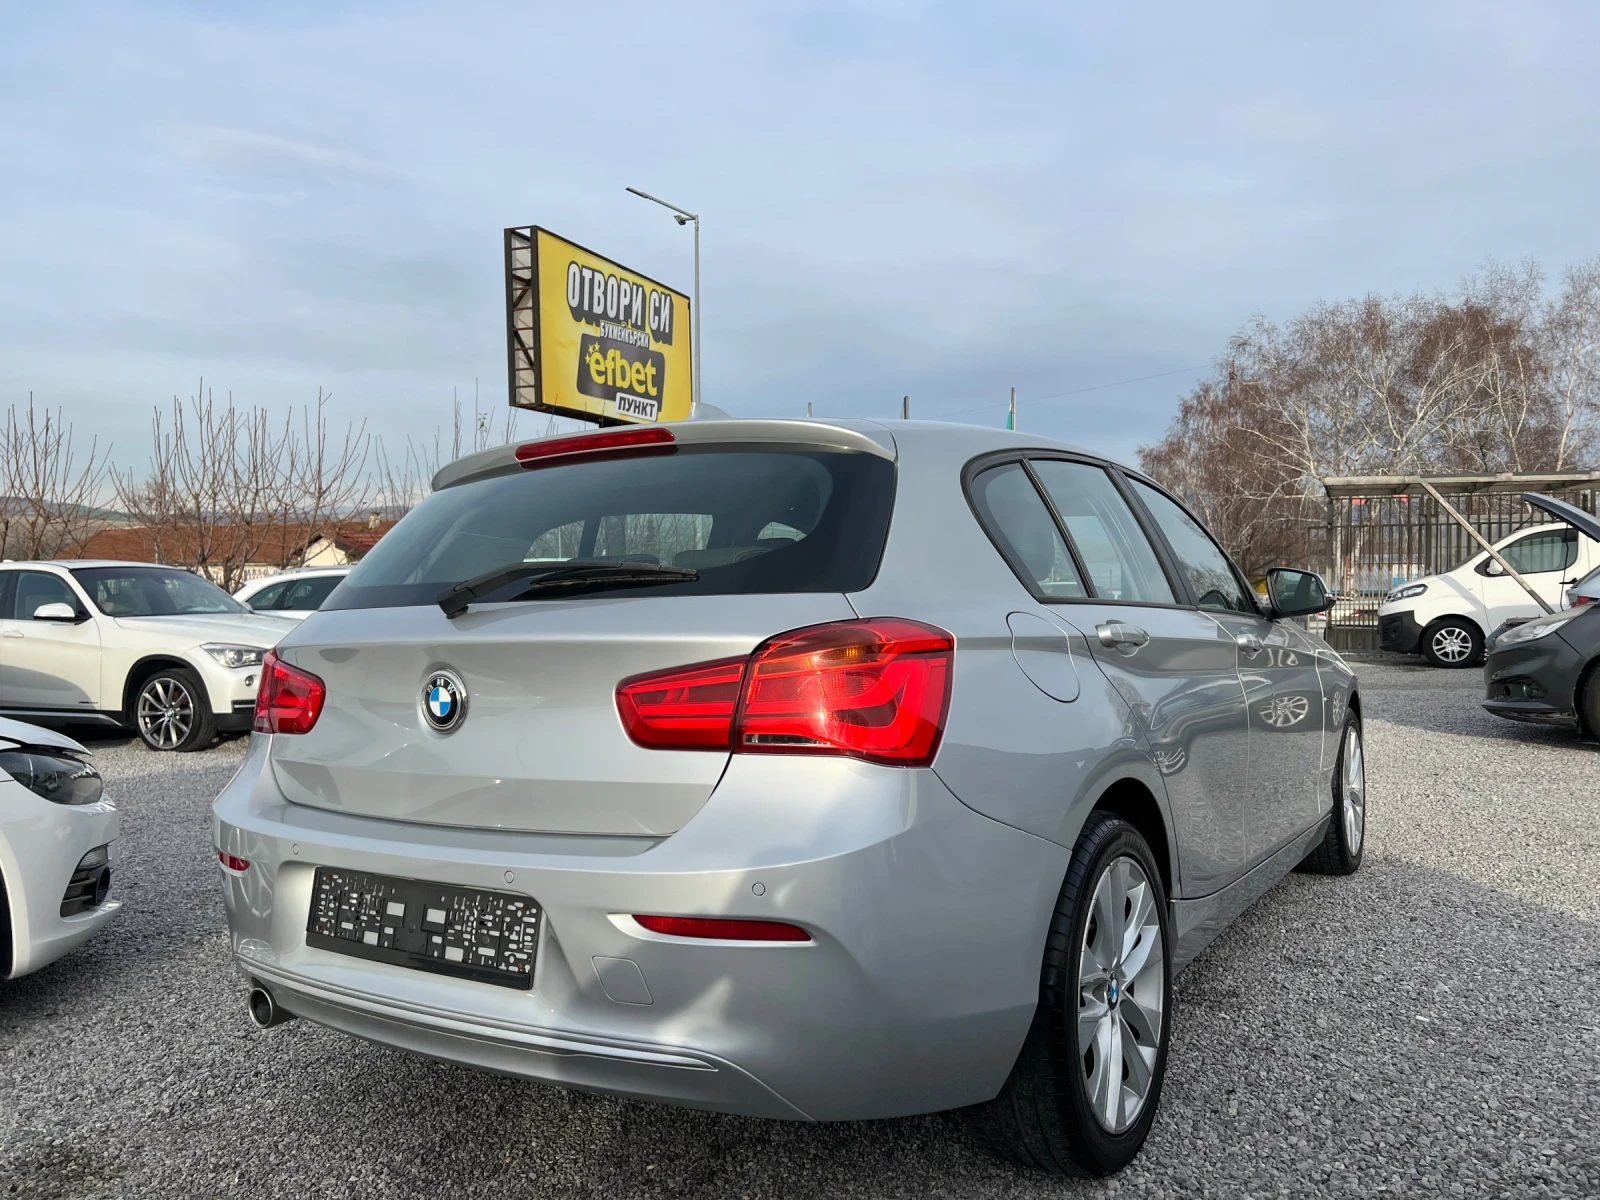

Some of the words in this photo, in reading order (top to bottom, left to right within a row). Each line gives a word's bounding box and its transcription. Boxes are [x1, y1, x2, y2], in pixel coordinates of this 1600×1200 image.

[567, 262, 644, 326] ОТВОРИ
[649, 289, 671, 333] СИ
[600, 322, 649, 348] БУКМЕЙКЪРСКИ
[589, 348, 658, 397] efbet
[617, 396, 656, 418] ПУНКТ
[427, 678, 456, 694] BMW
